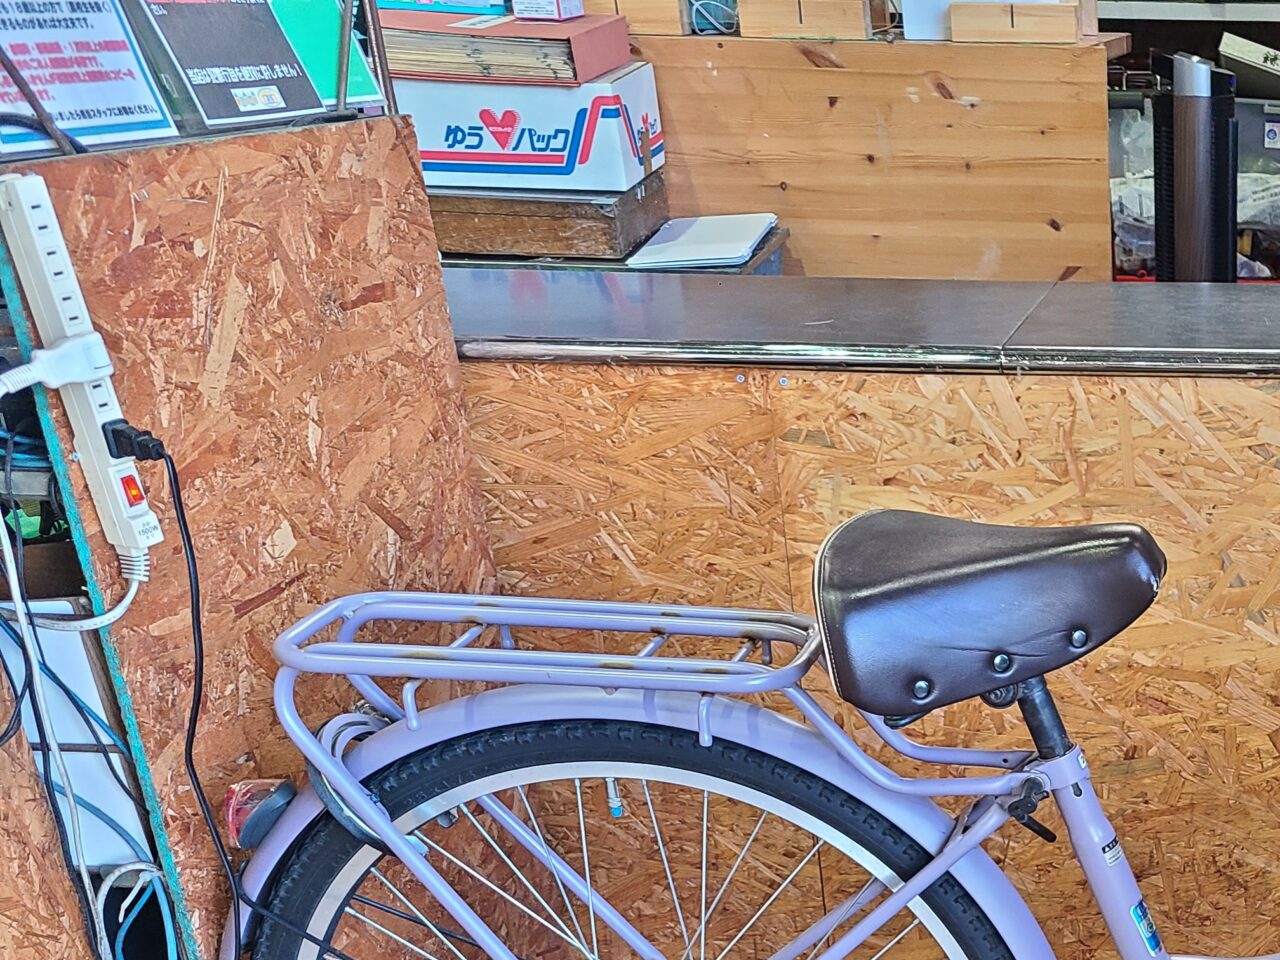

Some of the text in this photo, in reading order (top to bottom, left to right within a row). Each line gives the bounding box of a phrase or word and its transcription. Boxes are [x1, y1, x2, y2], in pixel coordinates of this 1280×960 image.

[444, 125, 570, 152] ゆう パック
[138, 524, 159, 537] 1500W
